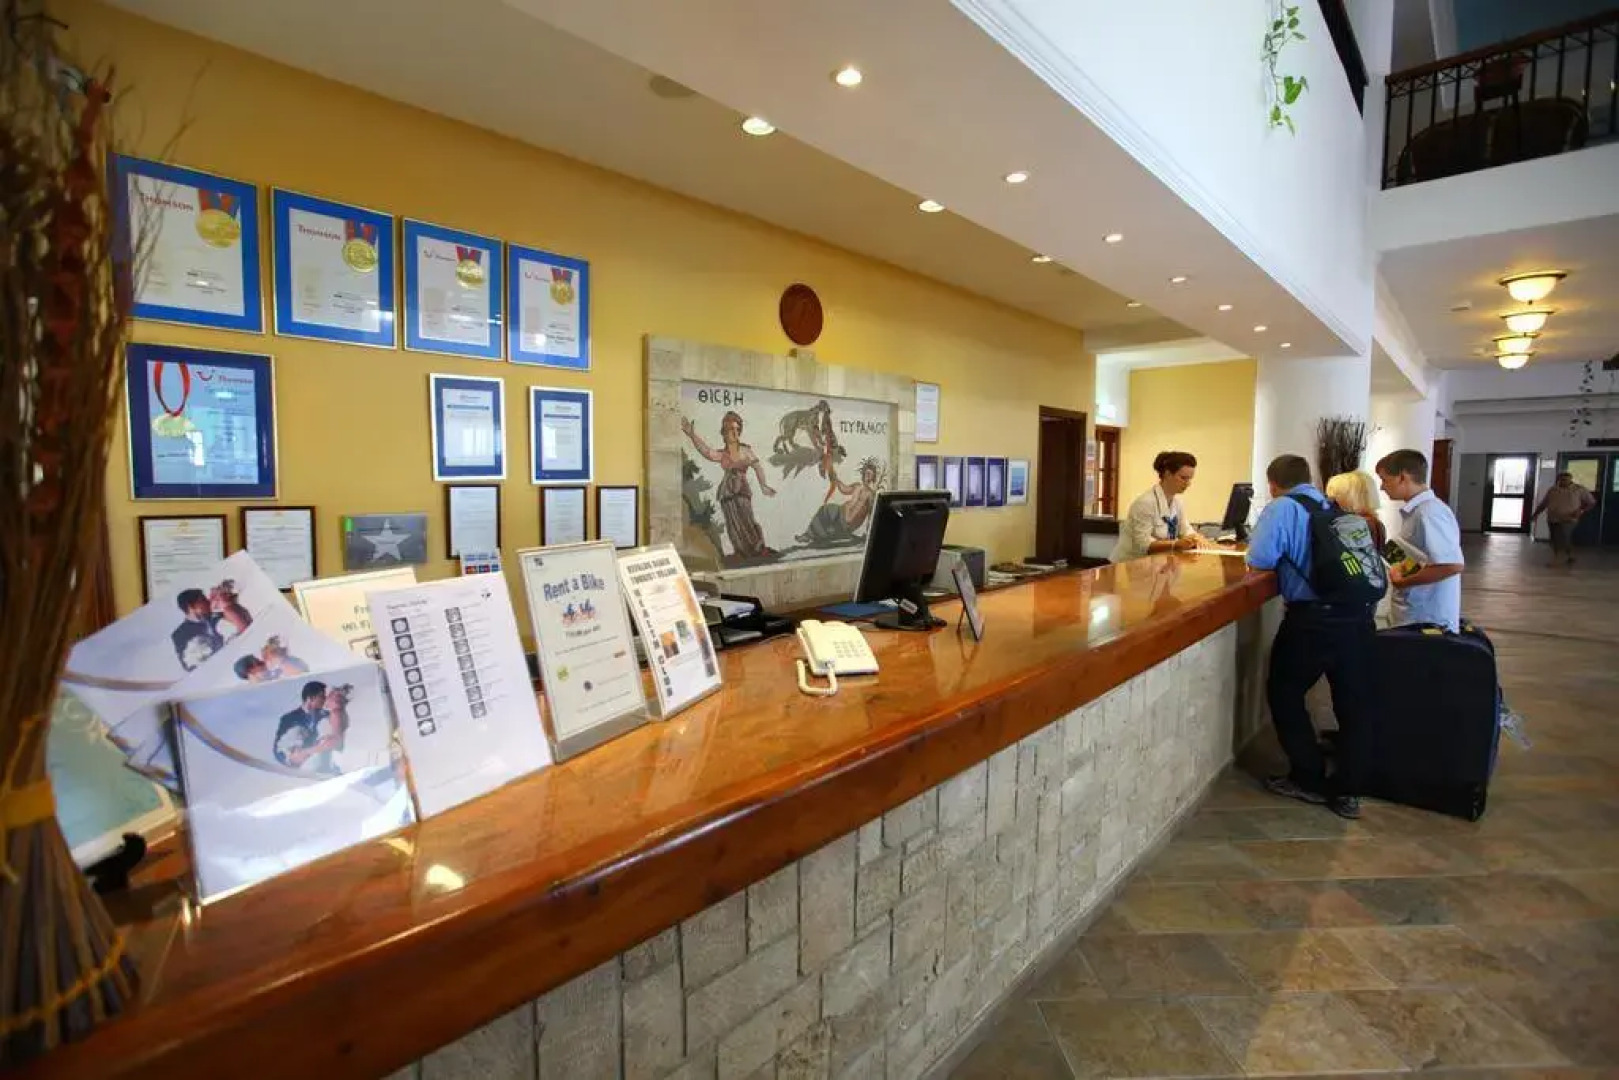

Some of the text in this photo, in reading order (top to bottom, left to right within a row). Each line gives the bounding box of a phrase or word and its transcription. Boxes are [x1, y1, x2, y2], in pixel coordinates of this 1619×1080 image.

[543, 571, 605, 601] Rent a Bike
